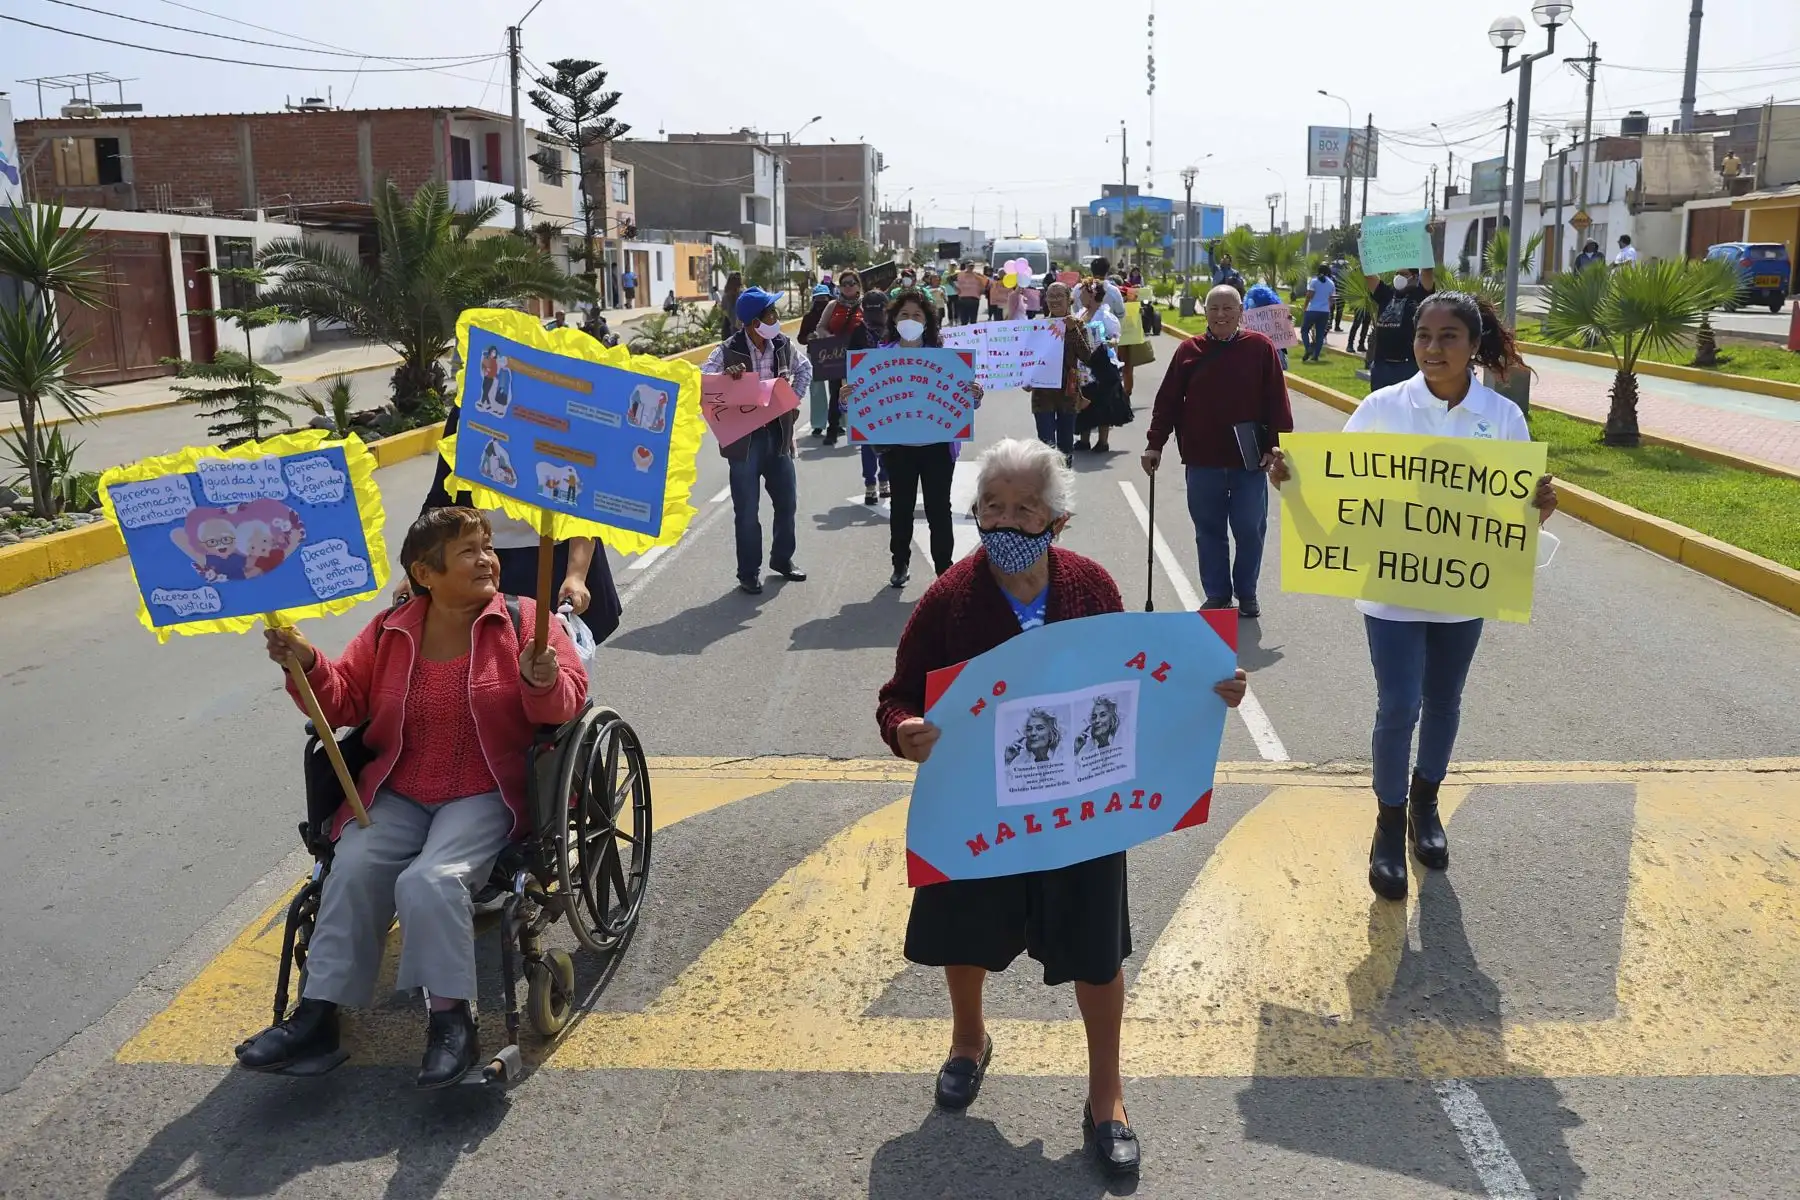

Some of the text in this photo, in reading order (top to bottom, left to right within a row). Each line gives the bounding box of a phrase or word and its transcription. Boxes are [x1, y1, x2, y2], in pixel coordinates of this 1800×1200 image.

[1319, 140, 1339, 151] BOX
[851, 358, 970, 394] NO DESPRECIES A UN
[853, 375, 971, 409] ANCIANO POR LO QUE
[858, 391, 962, 419] NO PUEDE HACER
[199, 461, 246, 472] Derecho
[264, 460, 275, 470] la
[287, 460, 329, 476] Derecho
[1325, 450, 1533, 499] LUCHAREMOS
[112, 487, 160, 503] Derecho
[176, 480, 188, 490] la
[1338, 499, 1526, 551] EN CONTRA
[303, 543, 342, 562] Derecho
[1303, 544, 1490, 590] DEL ABUSO
[205, 588, 216, 600] la
[970, 651, 1171, 717] NO AL
